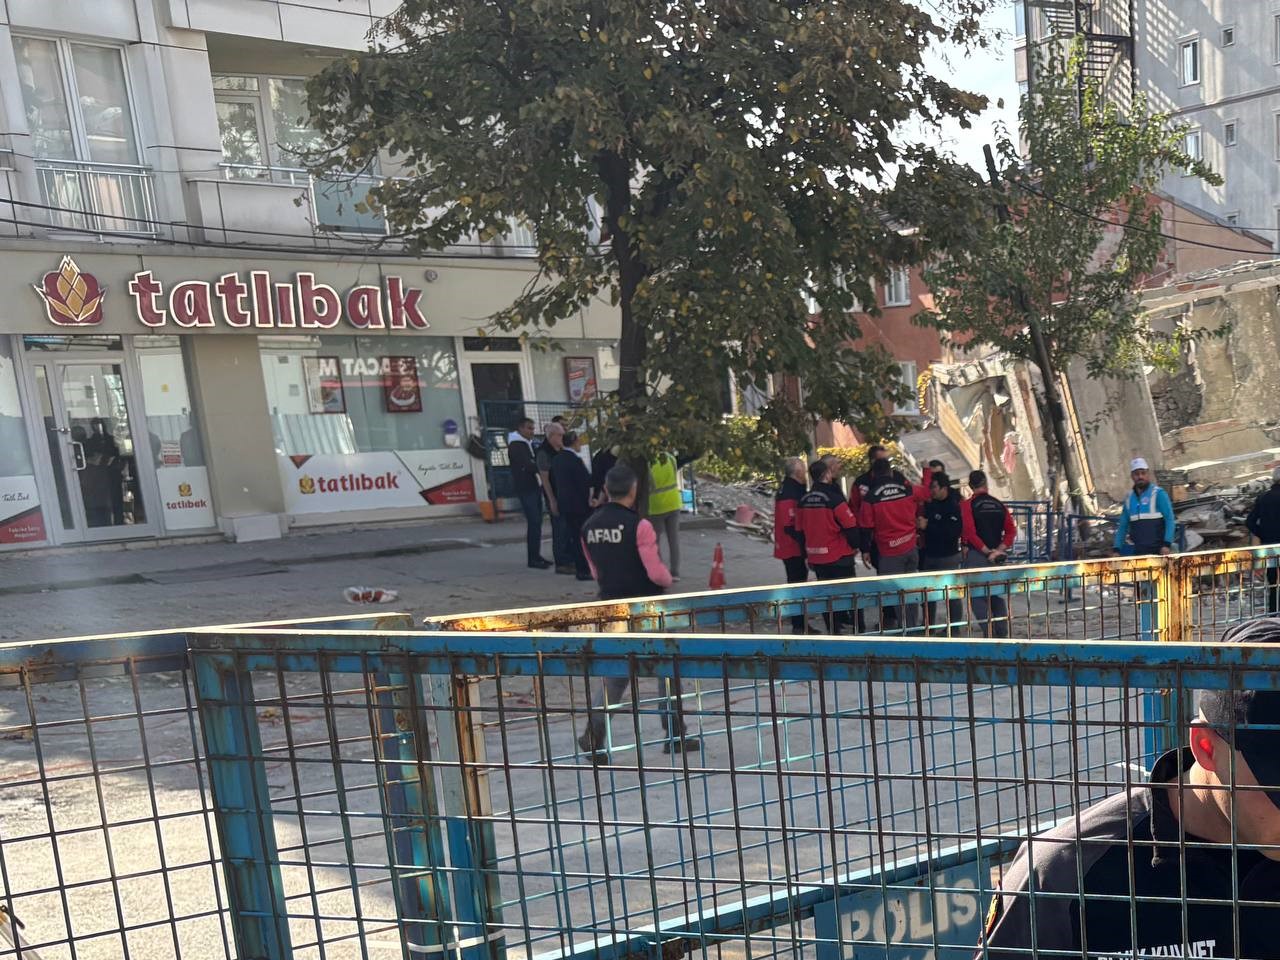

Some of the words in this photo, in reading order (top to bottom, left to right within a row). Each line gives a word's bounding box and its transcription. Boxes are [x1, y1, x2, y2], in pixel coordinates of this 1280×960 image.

[128, 270, 431, 330] tatlıbak
[318, 471, 400, 493] tatlıbak
[166, 499, 207, 510] tatlıbak
[587, 528, 622, 544] AFAD
